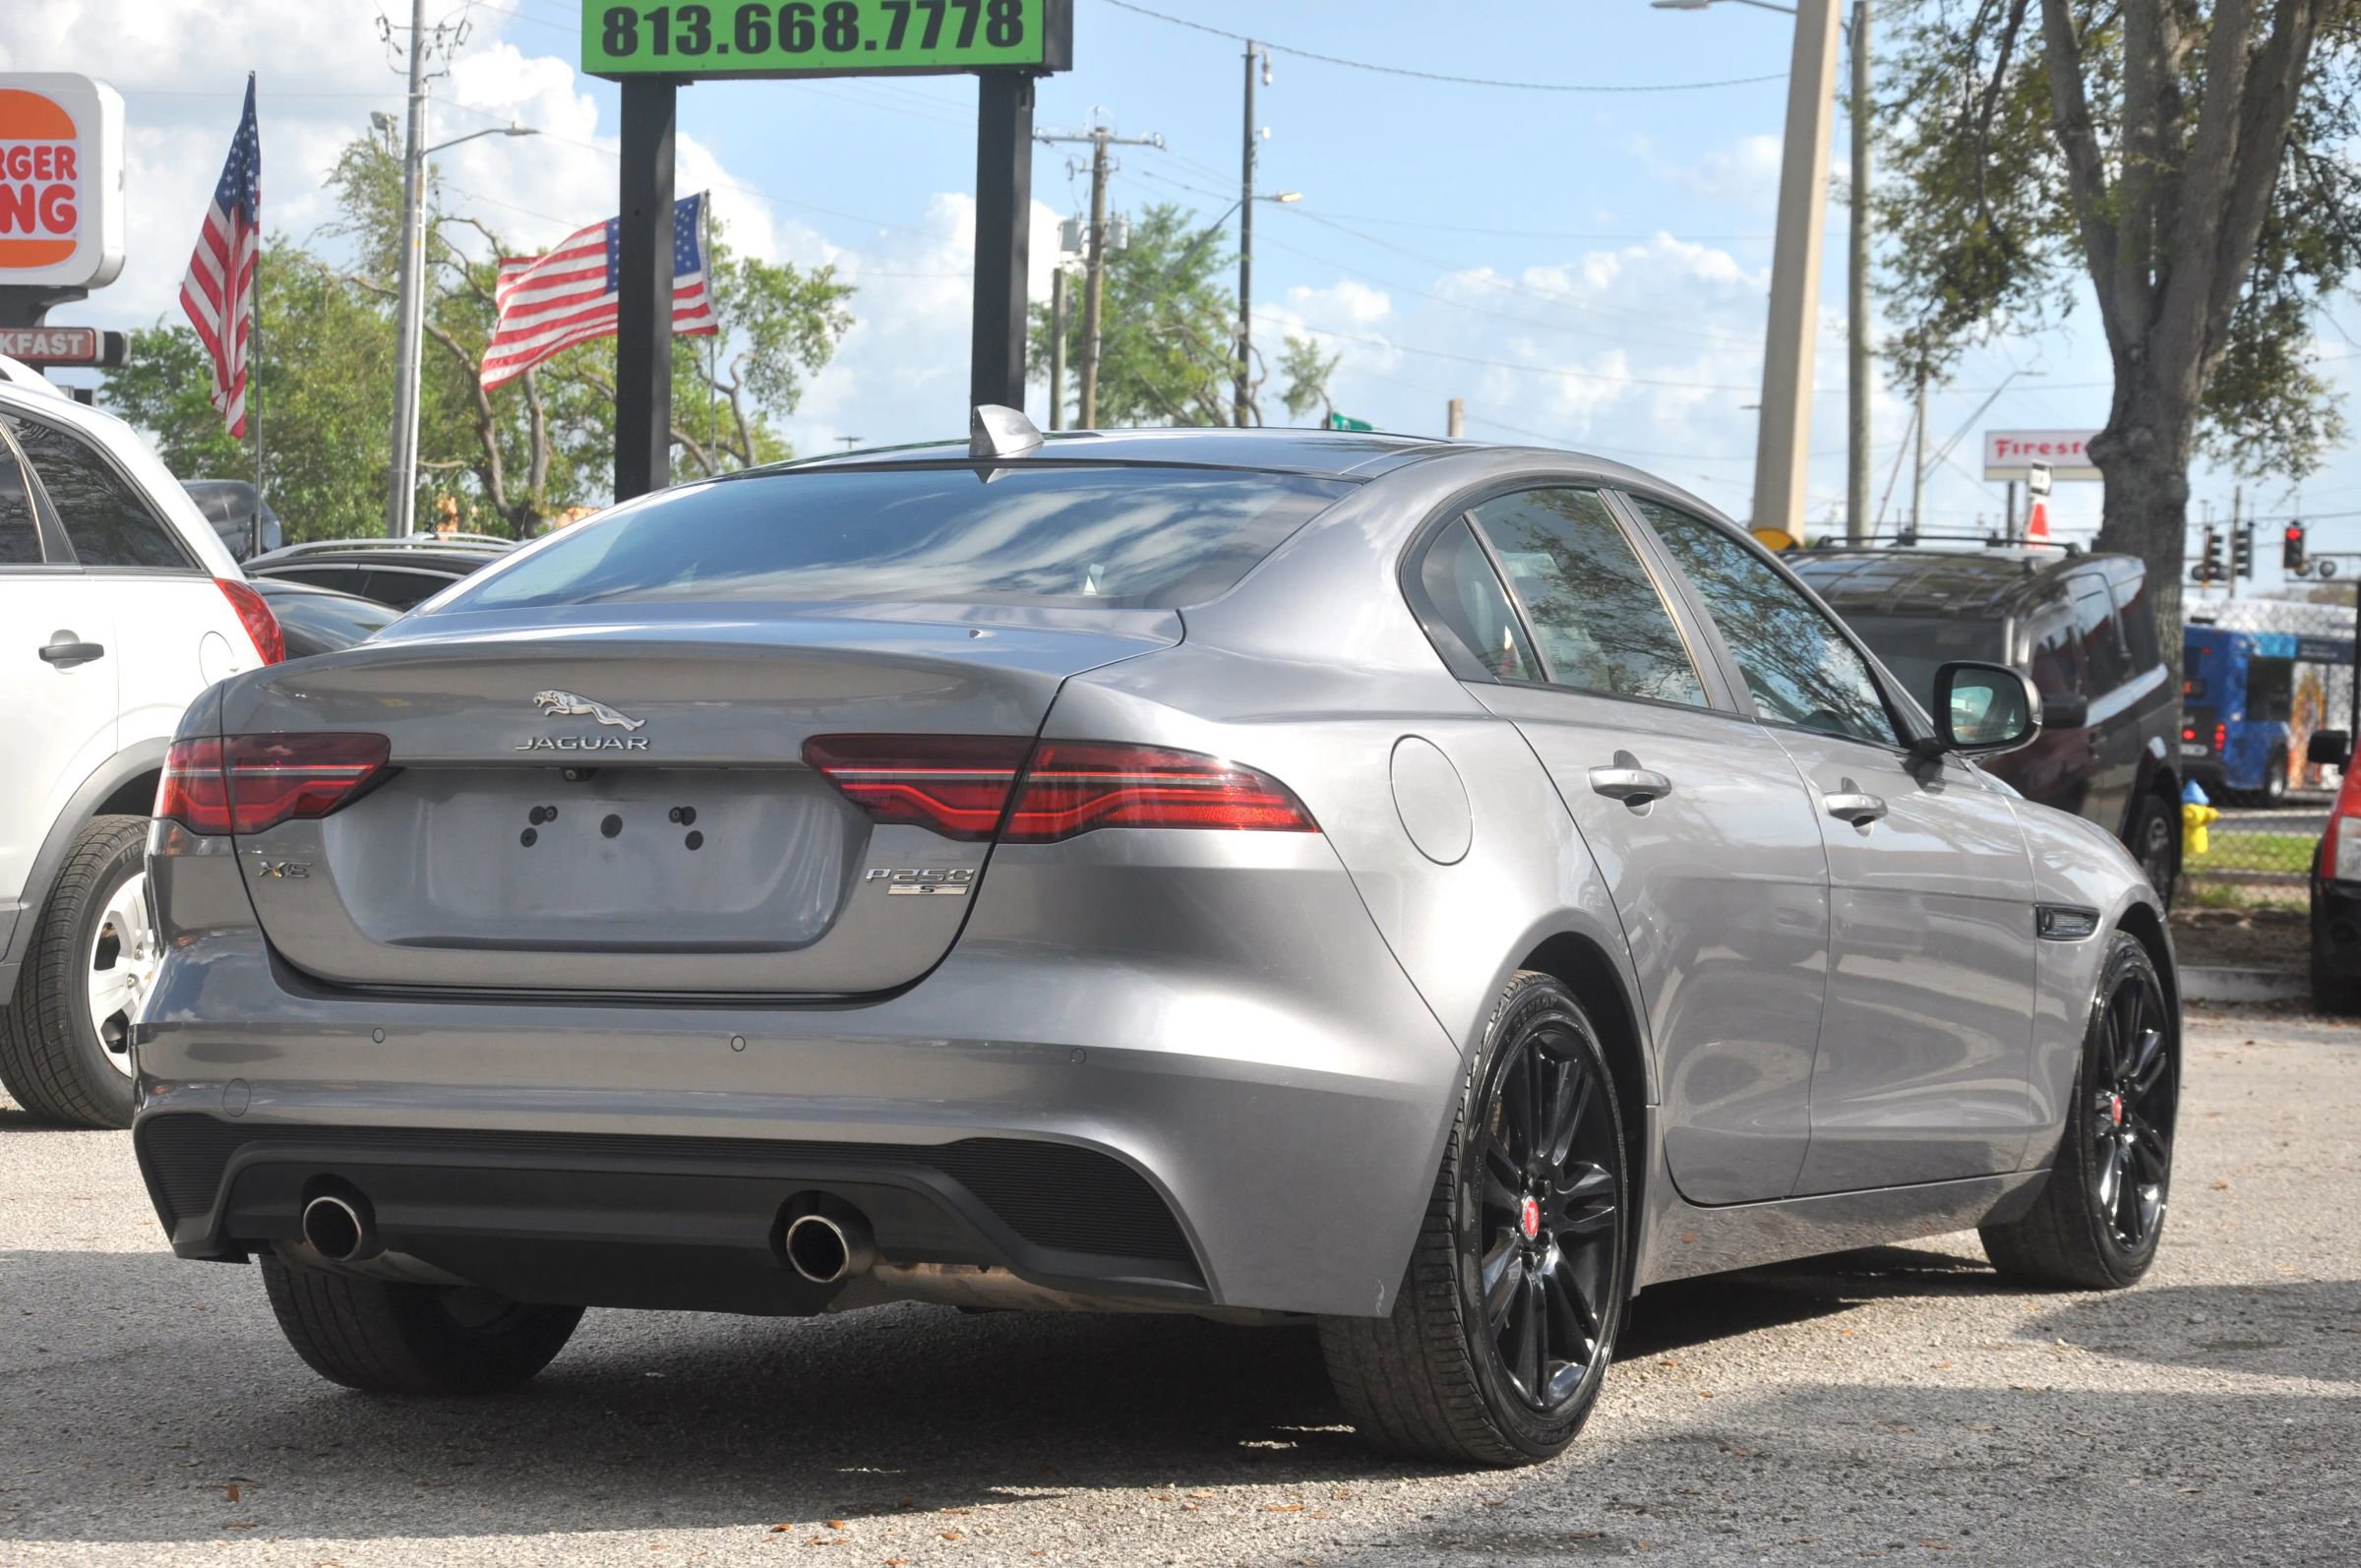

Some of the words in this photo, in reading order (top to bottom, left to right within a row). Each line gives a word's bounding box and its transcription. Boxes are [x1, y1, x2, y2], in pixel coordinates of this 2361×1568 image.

[602, 0, 1024, 57] 813.668.7778
[0, 146, 78, 181] GER
[0, 332, 85, 355] KFAST
[1994, 439, 2087, 458] Firest
[515, 736, 650, 751] JAGUAR
[260, 862, 312, 877] XE
[866, 869, 975, 882] P250
